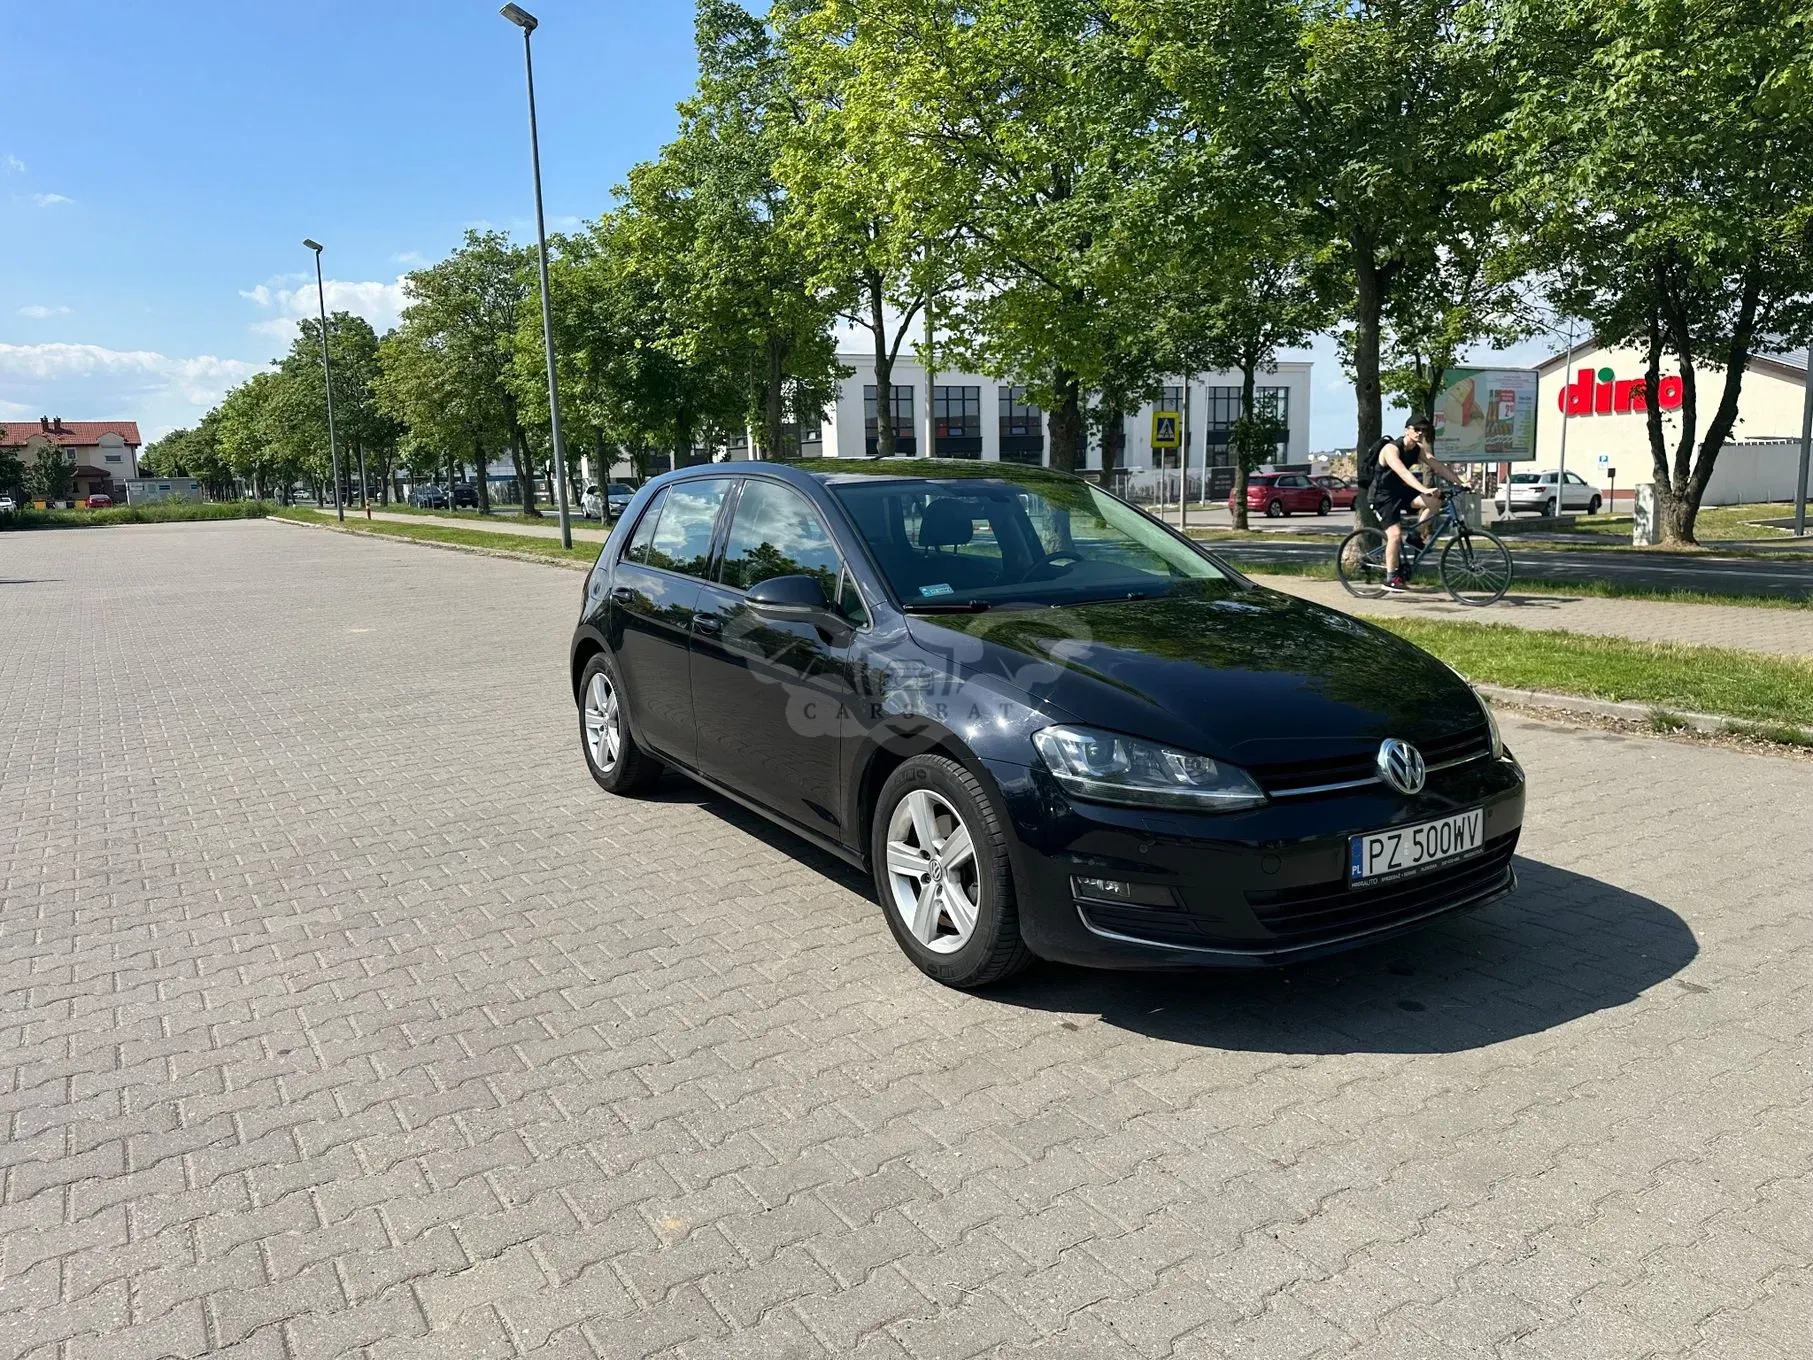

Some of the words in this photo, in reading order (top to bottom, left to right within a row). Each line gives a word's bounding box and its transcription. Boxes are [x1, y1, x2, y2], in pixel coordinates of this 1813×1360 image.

[1558, 367, 1683, 418] dino
[1369, 833, 1402, 874] PZ
[1412, 813, 1479, 863] 500WV
[1351, 864, 1362, 876] PL
